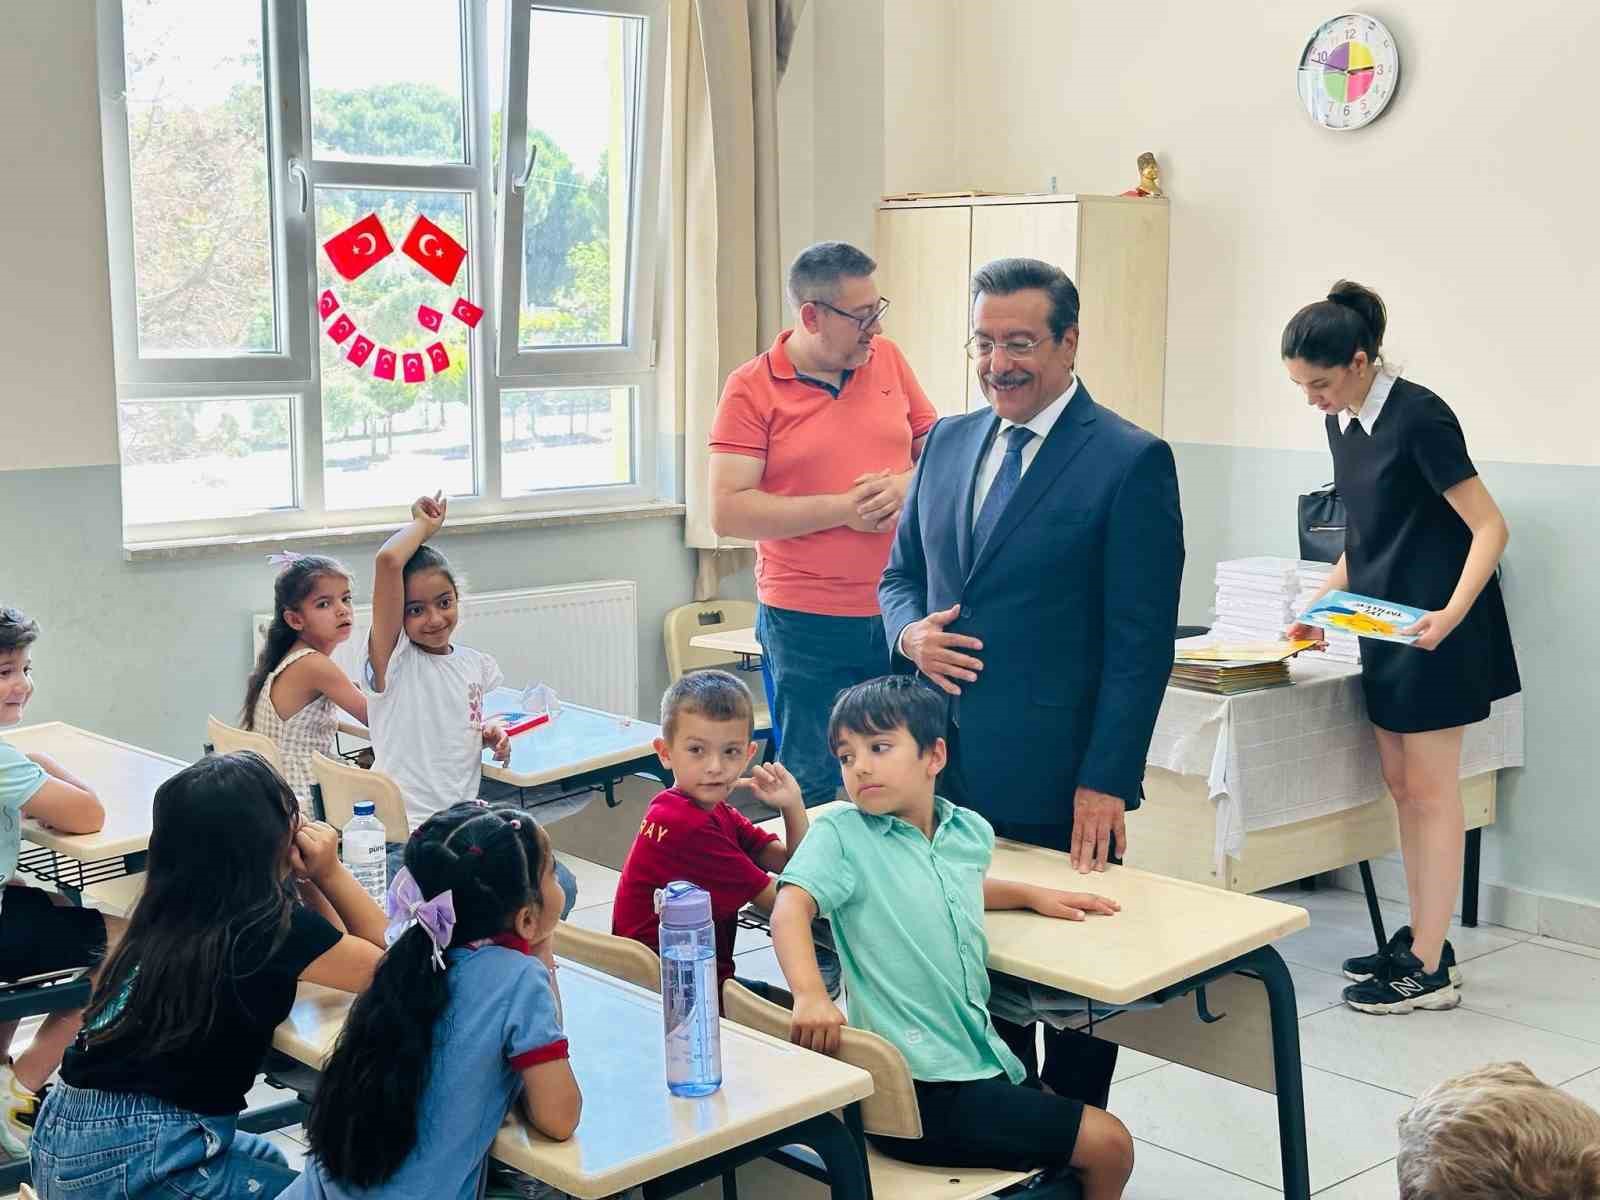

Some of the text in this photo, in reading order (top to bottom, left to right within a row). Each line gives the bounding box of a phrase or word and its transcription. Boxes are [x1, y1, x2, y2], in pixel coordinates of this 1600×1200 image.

[1345, 28, 1356, 39] 12
[1317, 51, 1328, 62] 10
[1377, 63, 1384, 75] 3
[1343, 105, 1351, 117] 6
